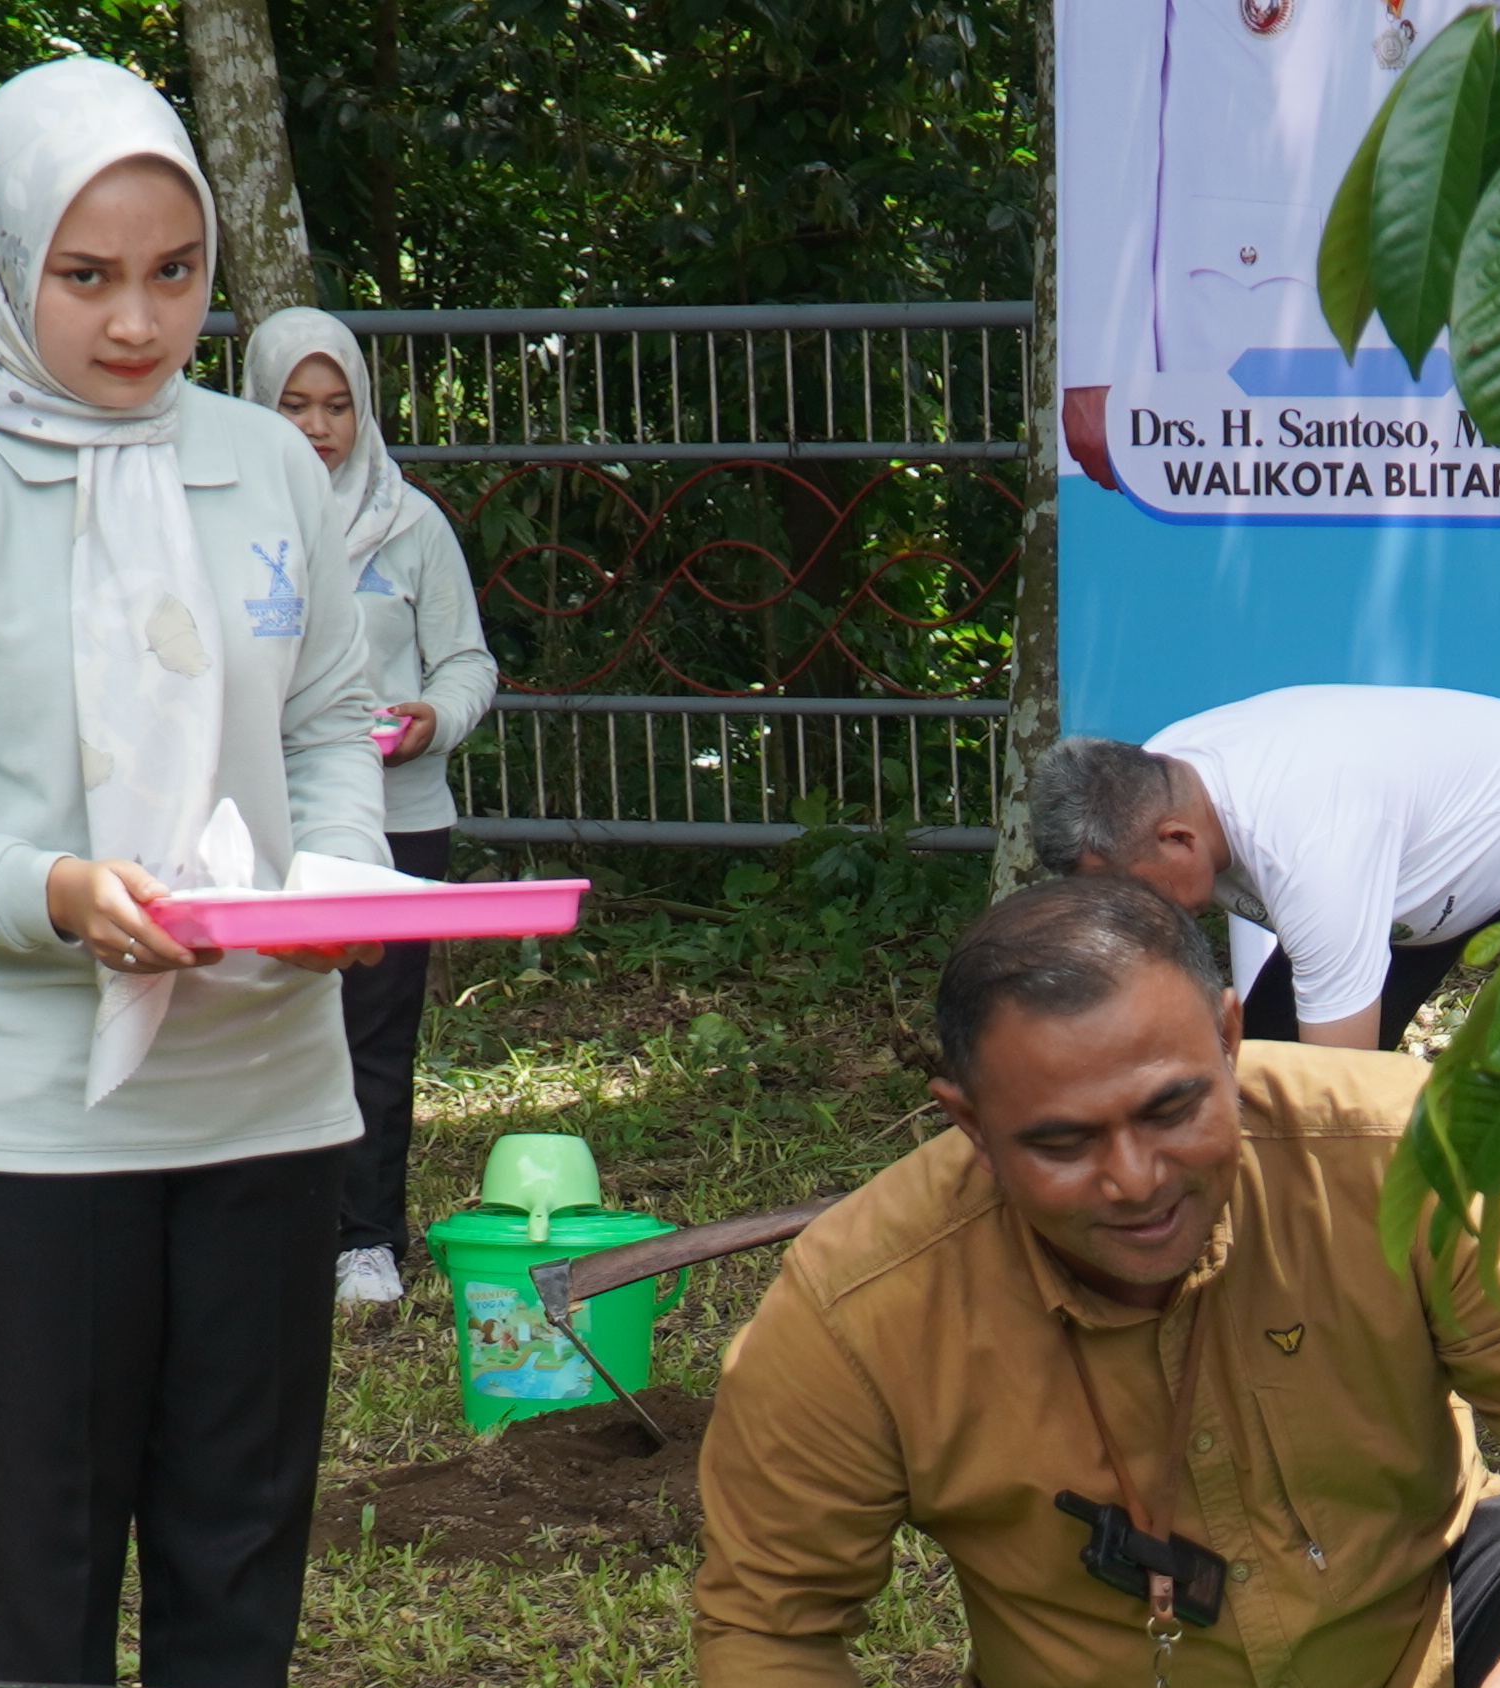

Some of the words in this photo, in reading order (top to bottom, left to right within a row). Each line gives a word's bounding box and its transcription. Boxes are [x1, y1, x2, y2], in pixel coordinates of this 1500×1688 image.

[1130, 408, 1206, 448] Drs.
[1221, 409, 1264, 448] H.
[1278, 409, 1440, 456] Santoso,
[1163, 460, 1373, 496] WALIKOTA
